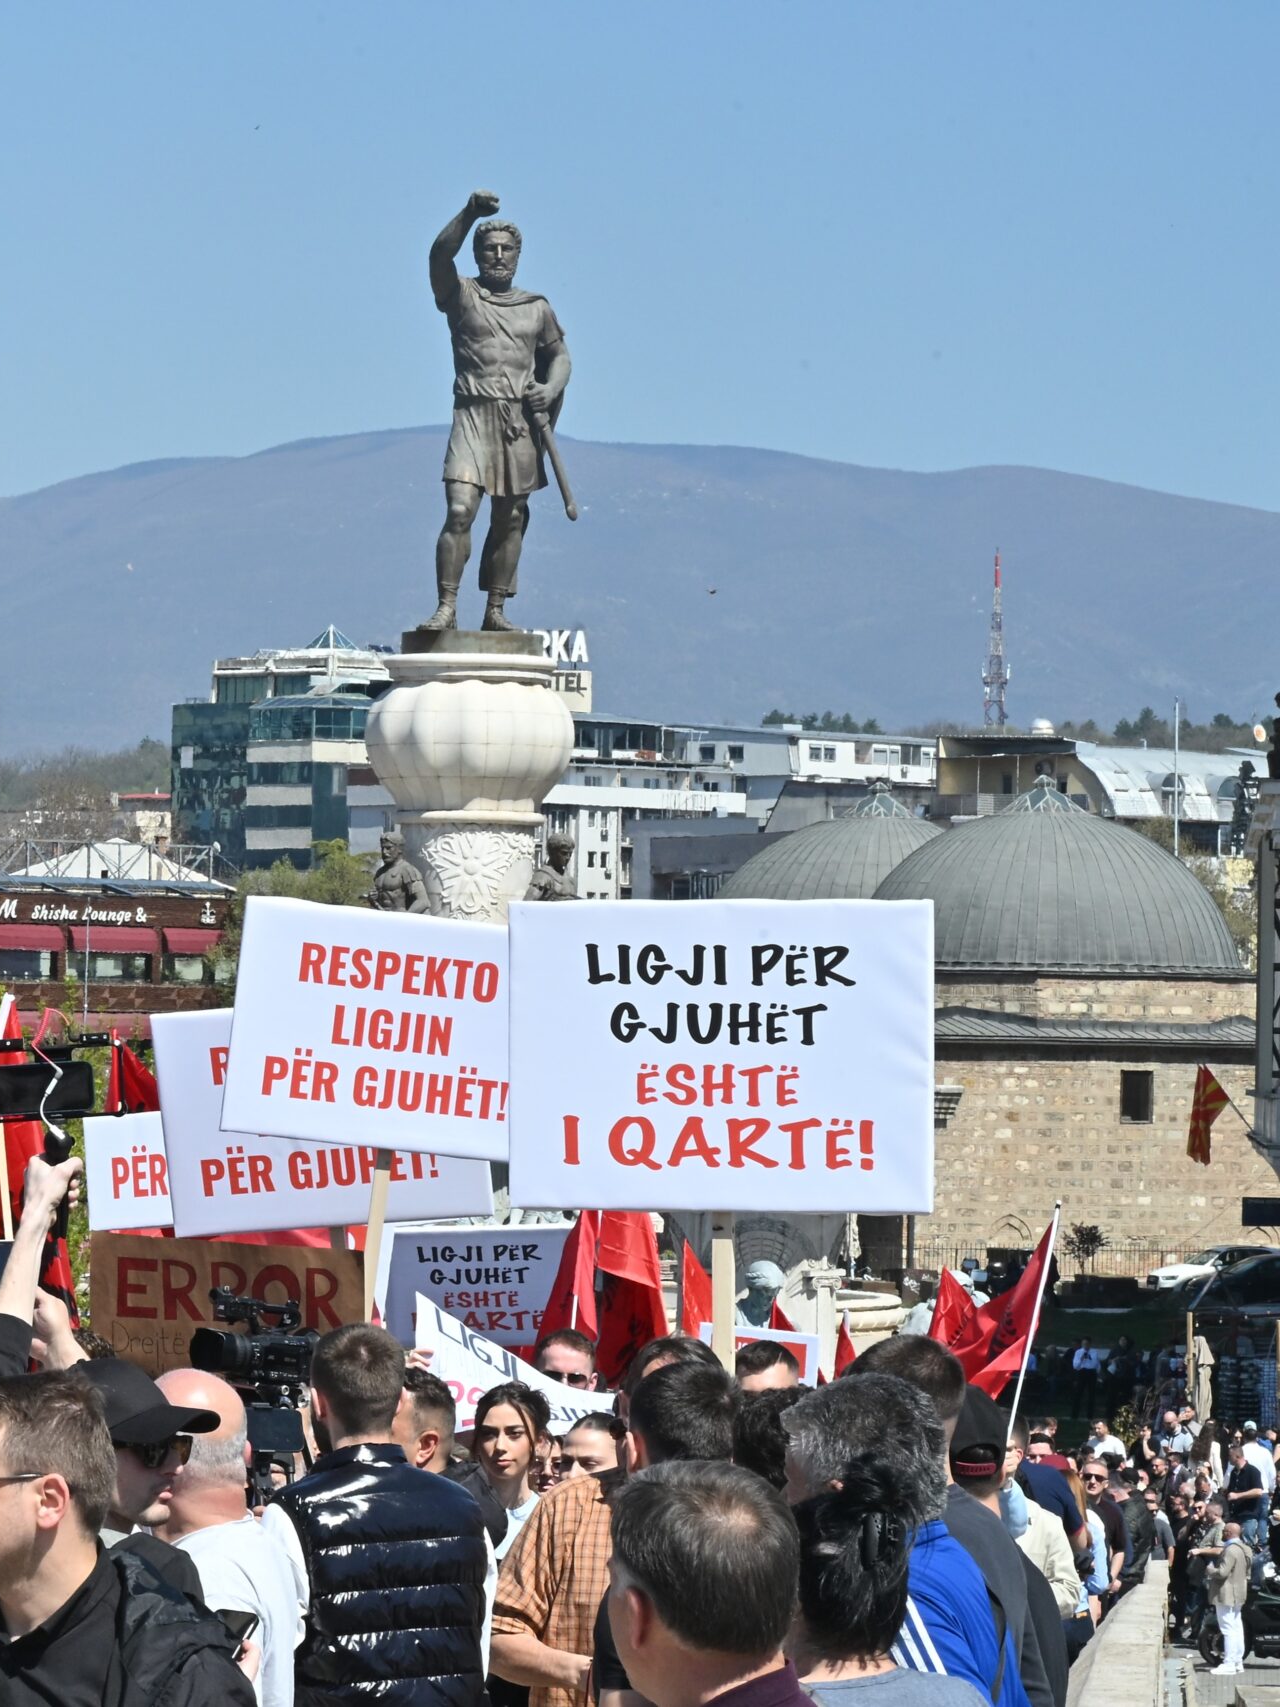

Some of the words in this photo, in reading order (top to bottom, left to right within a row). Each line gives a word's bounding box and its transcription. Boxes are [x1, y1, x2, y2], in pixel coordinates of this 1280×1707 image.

[31, 904, 78, 921] Shisha
[82, 905, 132, 925] Lounge
[135, 907, 147, 923] &
[298, 942, 500, 1003] RESPEKTO
[585, 943, 728, 986] LIGJI
[751, 944, 857, 987] PËR
[331, 1004, 453, 1057] LIGJIN
[610, 1002, 828, 1046] GJUHËT
[261, 1047, 339, 1103] PËR
[352, 1065, 509, 1122] GJUHËT!
[636, 1063, 800, 1107] ËSHTË
[563, 1114, 580, 1165] I
[608, 1115, 874, 1171] QARTË!
[200, 1145, 275, 1198] PËR
[416, 1245, 483, 1263] LIGJI
[493, 1244, 542, 1262] PËR
[116, 1256, 343, 1330] ERROR
[430, 1266, 530, 1286] GJUHËT
[444, 1290, 519, 1309] ËSHTË
[463, 1310, 546, 1332] ARTË
[434, 1306, 519, 1381] LIGJI
